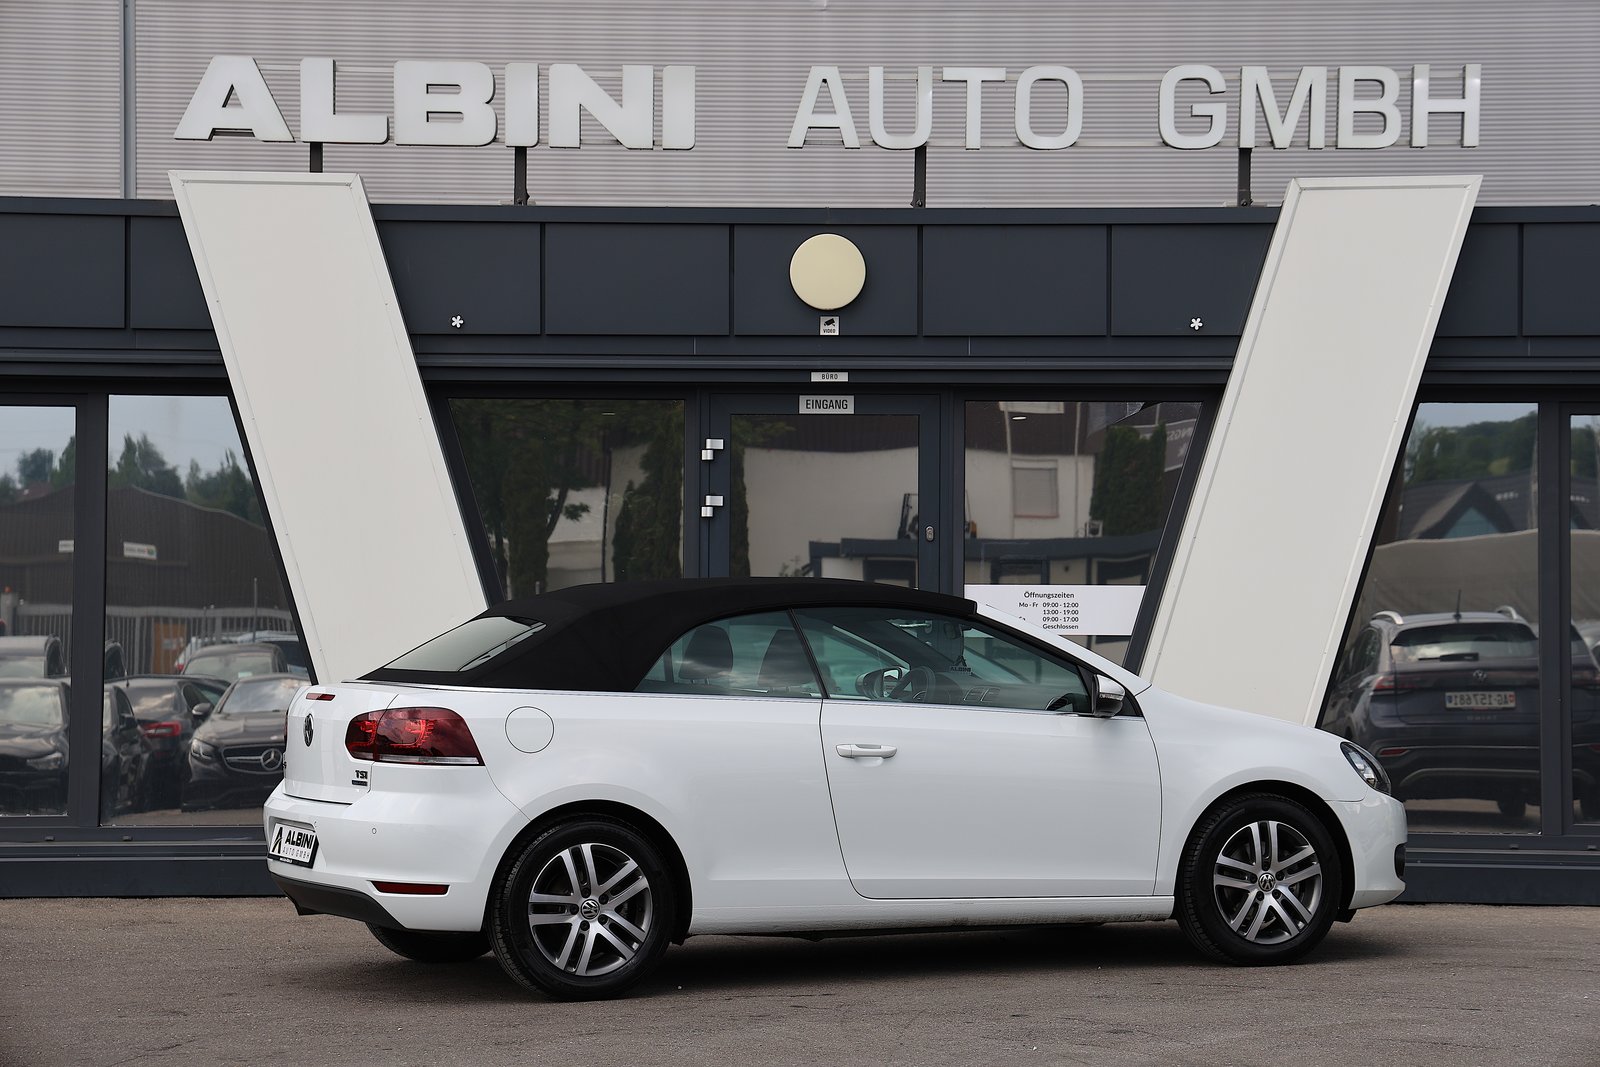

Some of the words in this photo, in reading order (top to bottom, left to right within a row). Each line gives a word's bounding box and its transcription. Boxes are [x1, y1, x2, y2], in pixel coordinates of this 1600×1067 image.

[173, 55, 696, 150] ALBINI
[787, 65, 1083, 150] AUTO
[1158, 63, 1481, 150] GMBH
[821, 372, 839, 380] BÜRO
[805, 399, 848, 410] EINGANG
[1023, 591, 1075, 599] Öffnungszeiten
[355, 769, 368, 779] TSI
[284, 829, 315, 849] ALBINI
